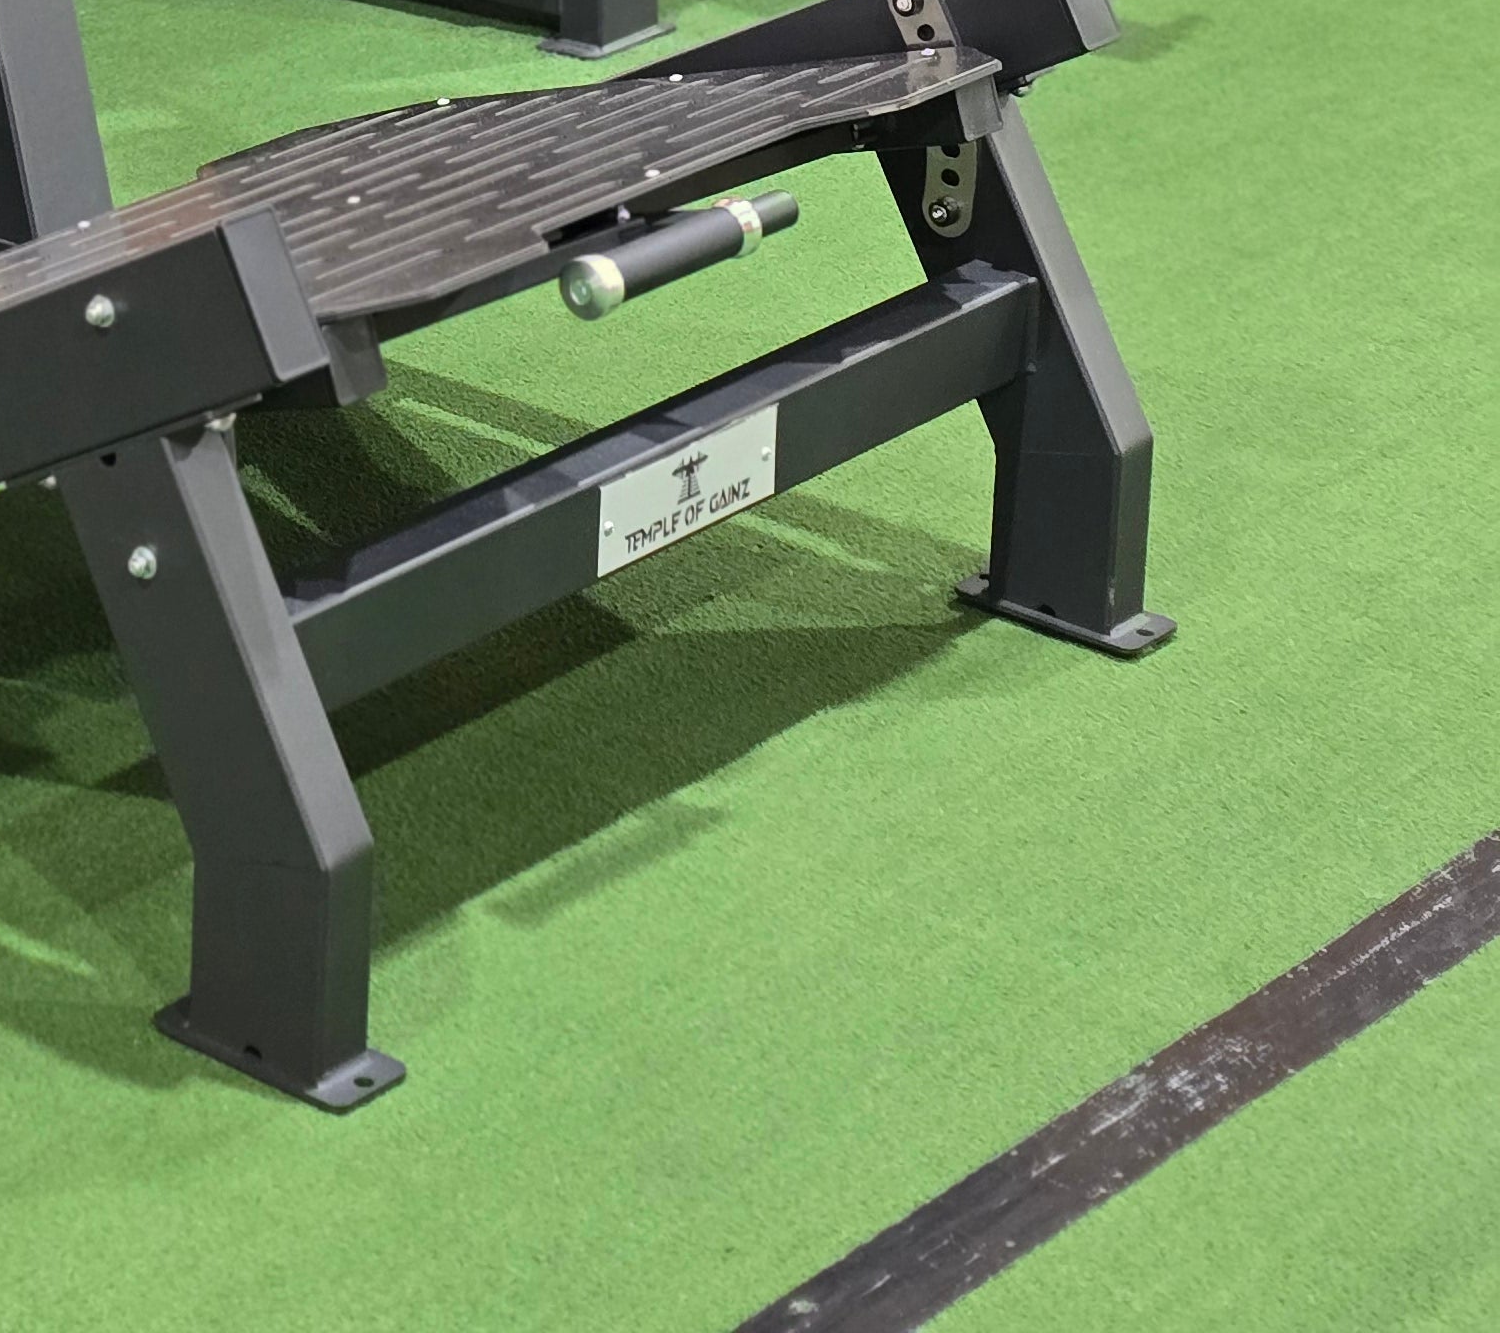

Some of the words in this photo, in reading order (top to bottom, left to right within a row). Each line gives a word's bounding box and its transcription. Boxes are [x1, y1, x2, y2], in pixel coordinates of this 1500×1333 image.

[625, 511, 681, 553] TEMPLE
[684, 499, 705, 526] OF
[709, 477, 751, 514] GAINZ
